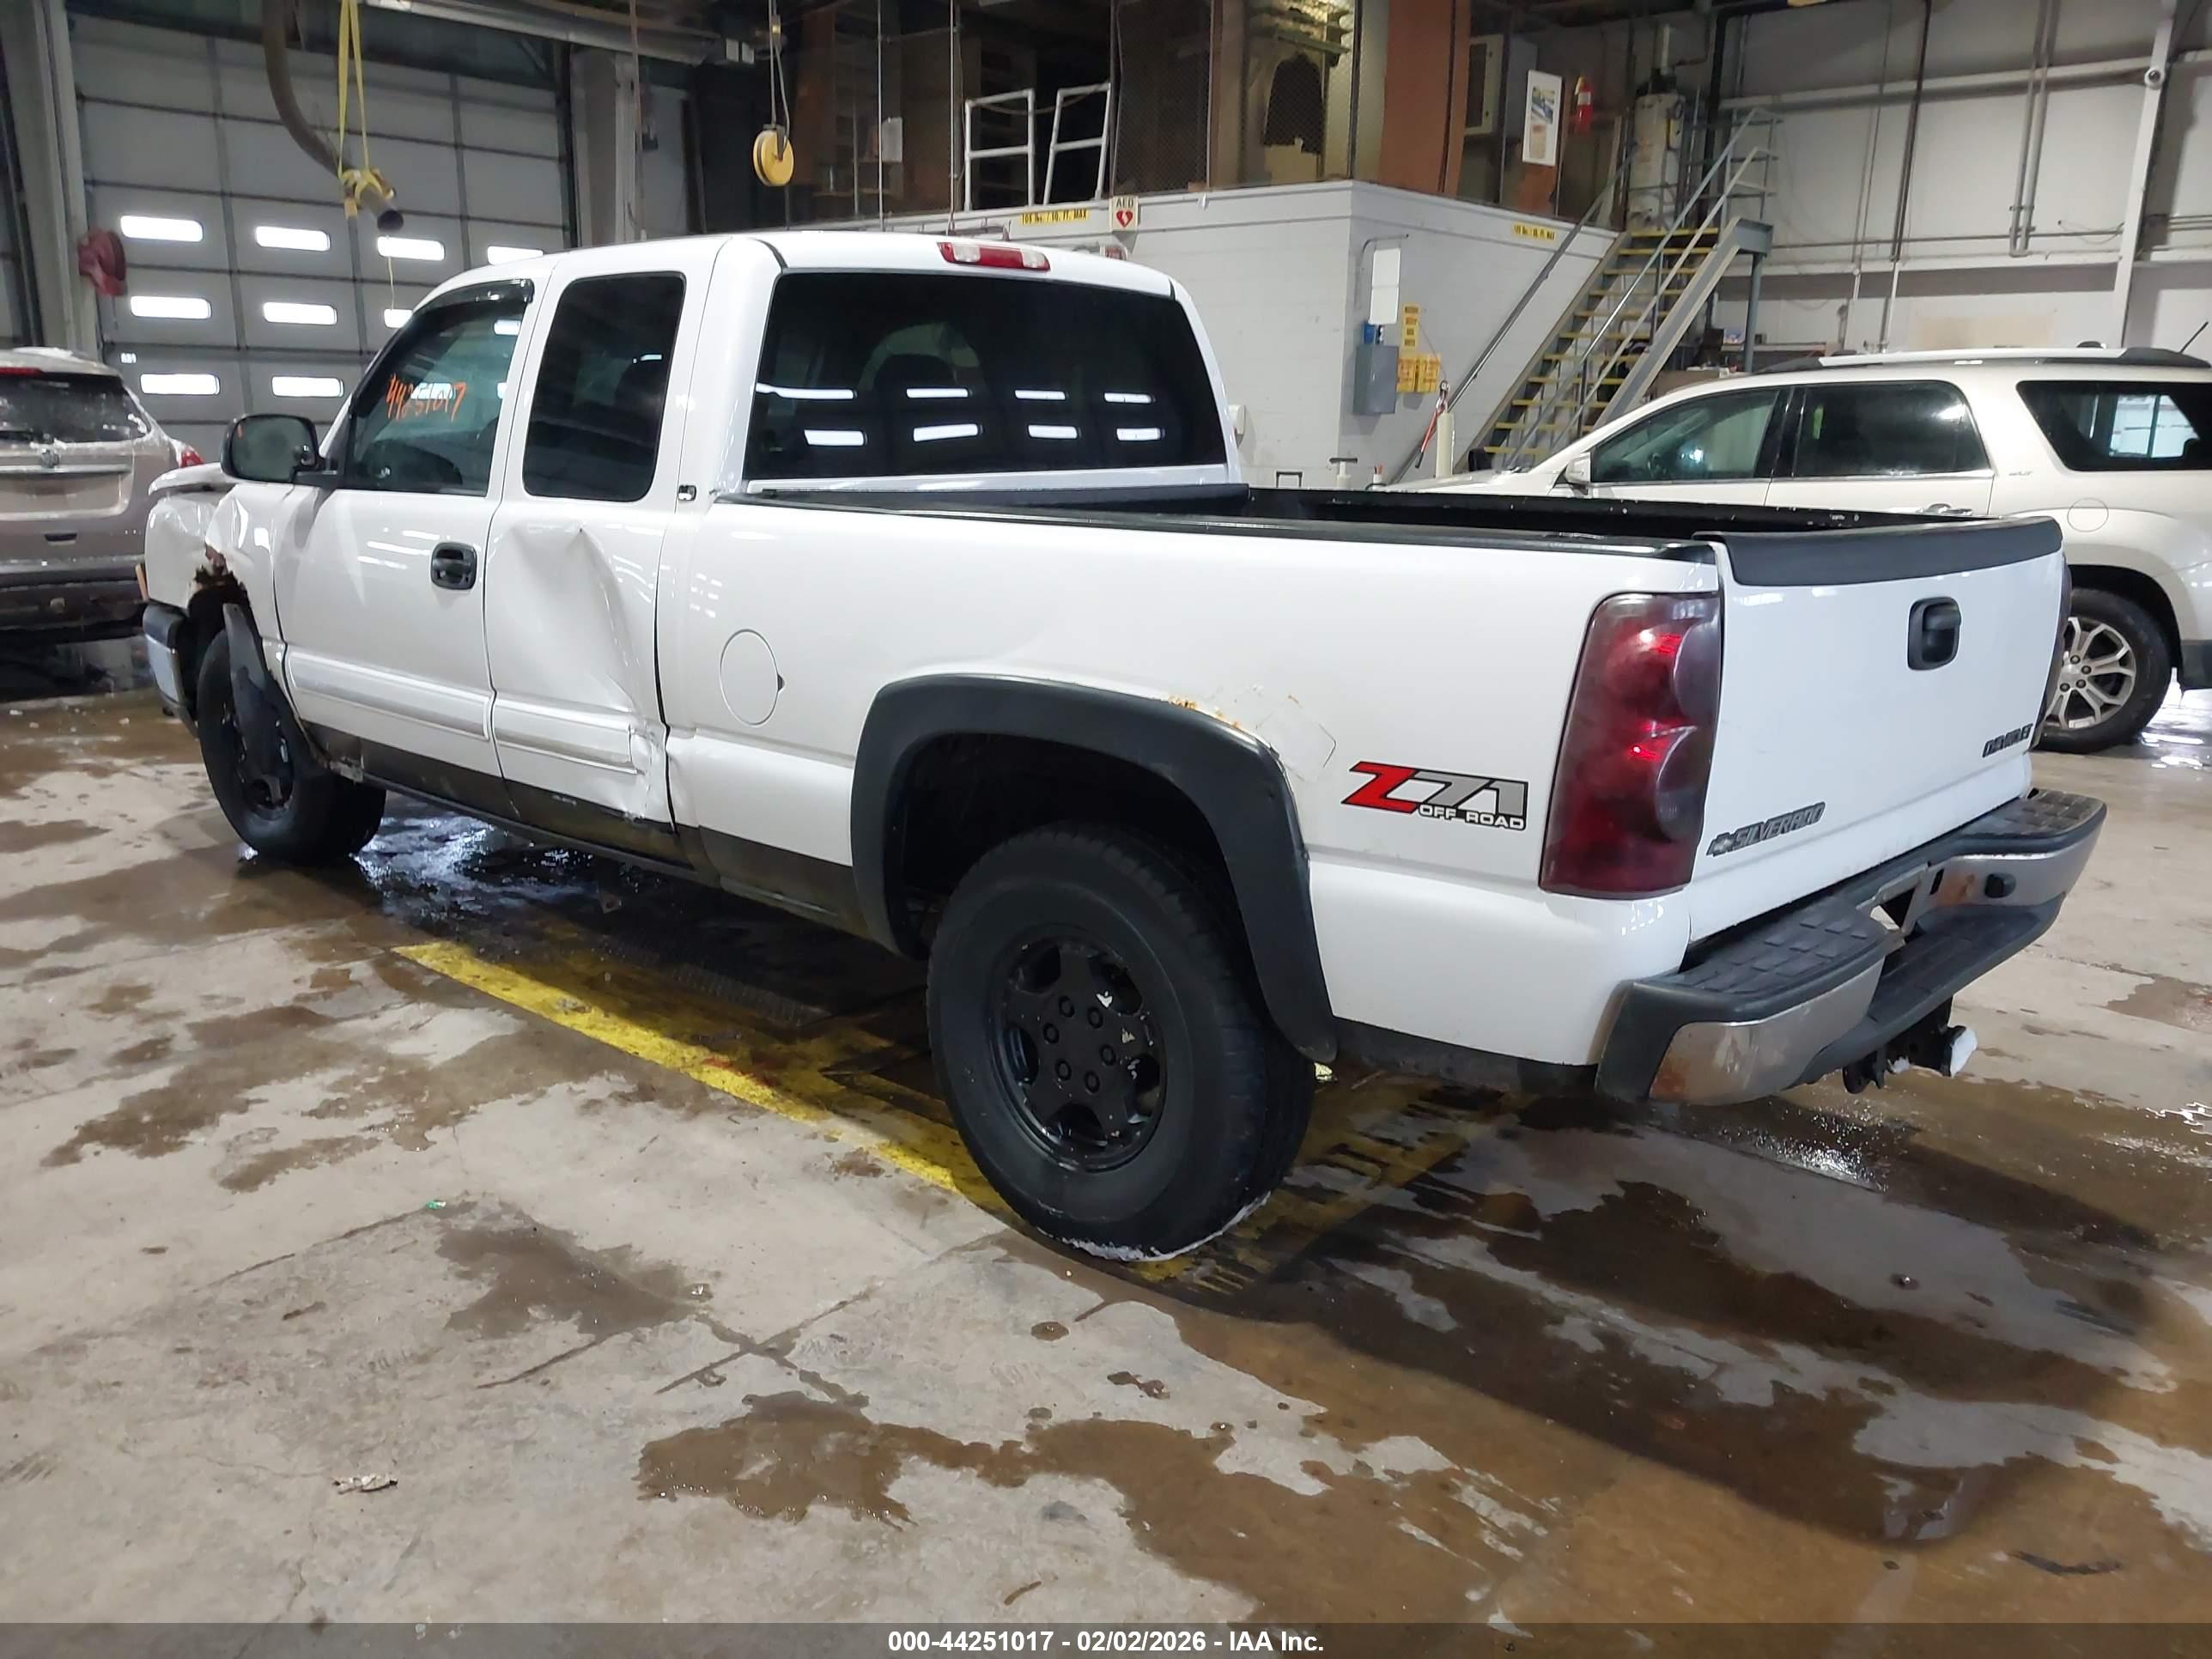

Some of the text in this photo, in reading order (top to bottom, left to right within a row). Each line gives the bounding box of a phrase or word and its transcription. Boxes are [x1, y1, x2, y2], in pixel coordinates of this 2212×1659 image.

[1115, 197, 1134, 208] AED
[1340, 761, 1528, 816] Z71
[1419, 804, 1525, 830] OFF ROAD
[1732, 801, 1826, 851] SILVERADO
